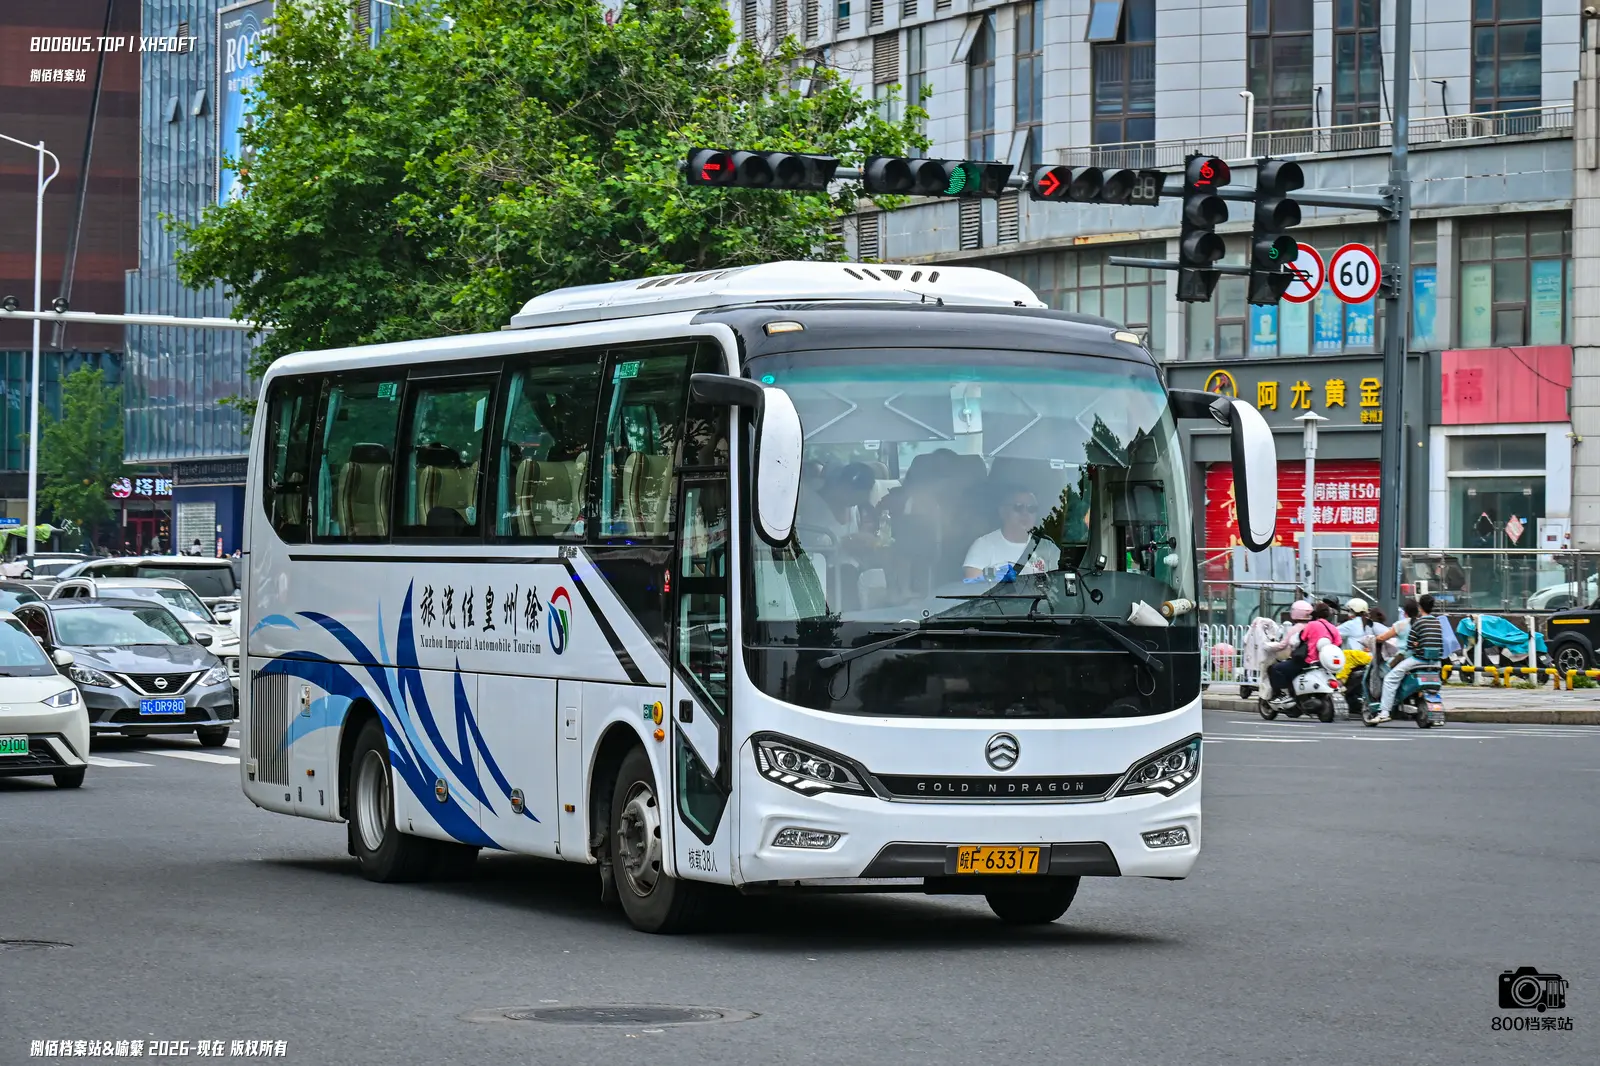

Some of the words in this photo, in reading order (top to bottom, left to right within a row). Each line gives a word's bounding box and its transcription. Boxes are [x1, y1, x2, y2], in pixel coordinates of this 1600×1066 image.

[1340, 261, 1369, 286] 60
[1257, 377, 1382, 412] 阿尤黄金
[1301, 482, 1380, 501] 间商铺150
[1297, 506, 1380, 525] 精装修/即租即
[420, 634, 443, 649] Xuzhou
[445, 635, 472, 653] Imperial
[474, 637, 511, 653] Automobile
[513, 639, 541, 655] Tourism
[1008, 781, 1085, 793] DRAGON
[688, 848, 718, 873] 核载38人
